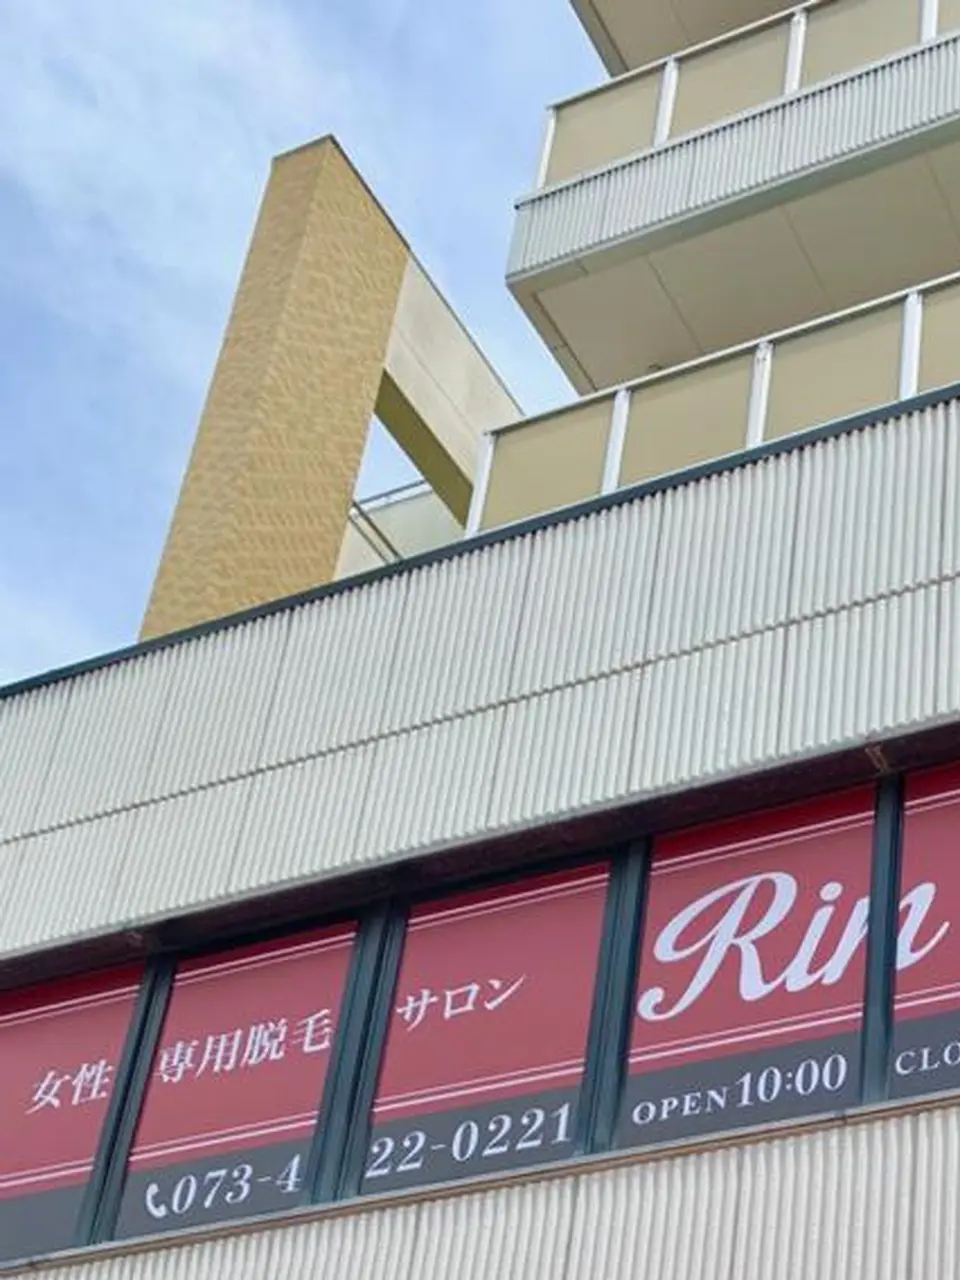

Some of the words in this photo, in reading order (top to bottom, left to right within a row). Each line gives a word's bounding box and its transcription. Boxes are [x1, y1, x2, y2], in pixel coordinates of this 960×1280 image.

[637, 871, 949, 1021] Rin
[395, 974, 527, 1031] サロン
[632, 1086, 729, 1125] OPEN
[735, 1054, 848, 1107] 10:00
[171, 1154, 303, 1215] 073-4
[366, 1103, 573, 1178] 22-0221
